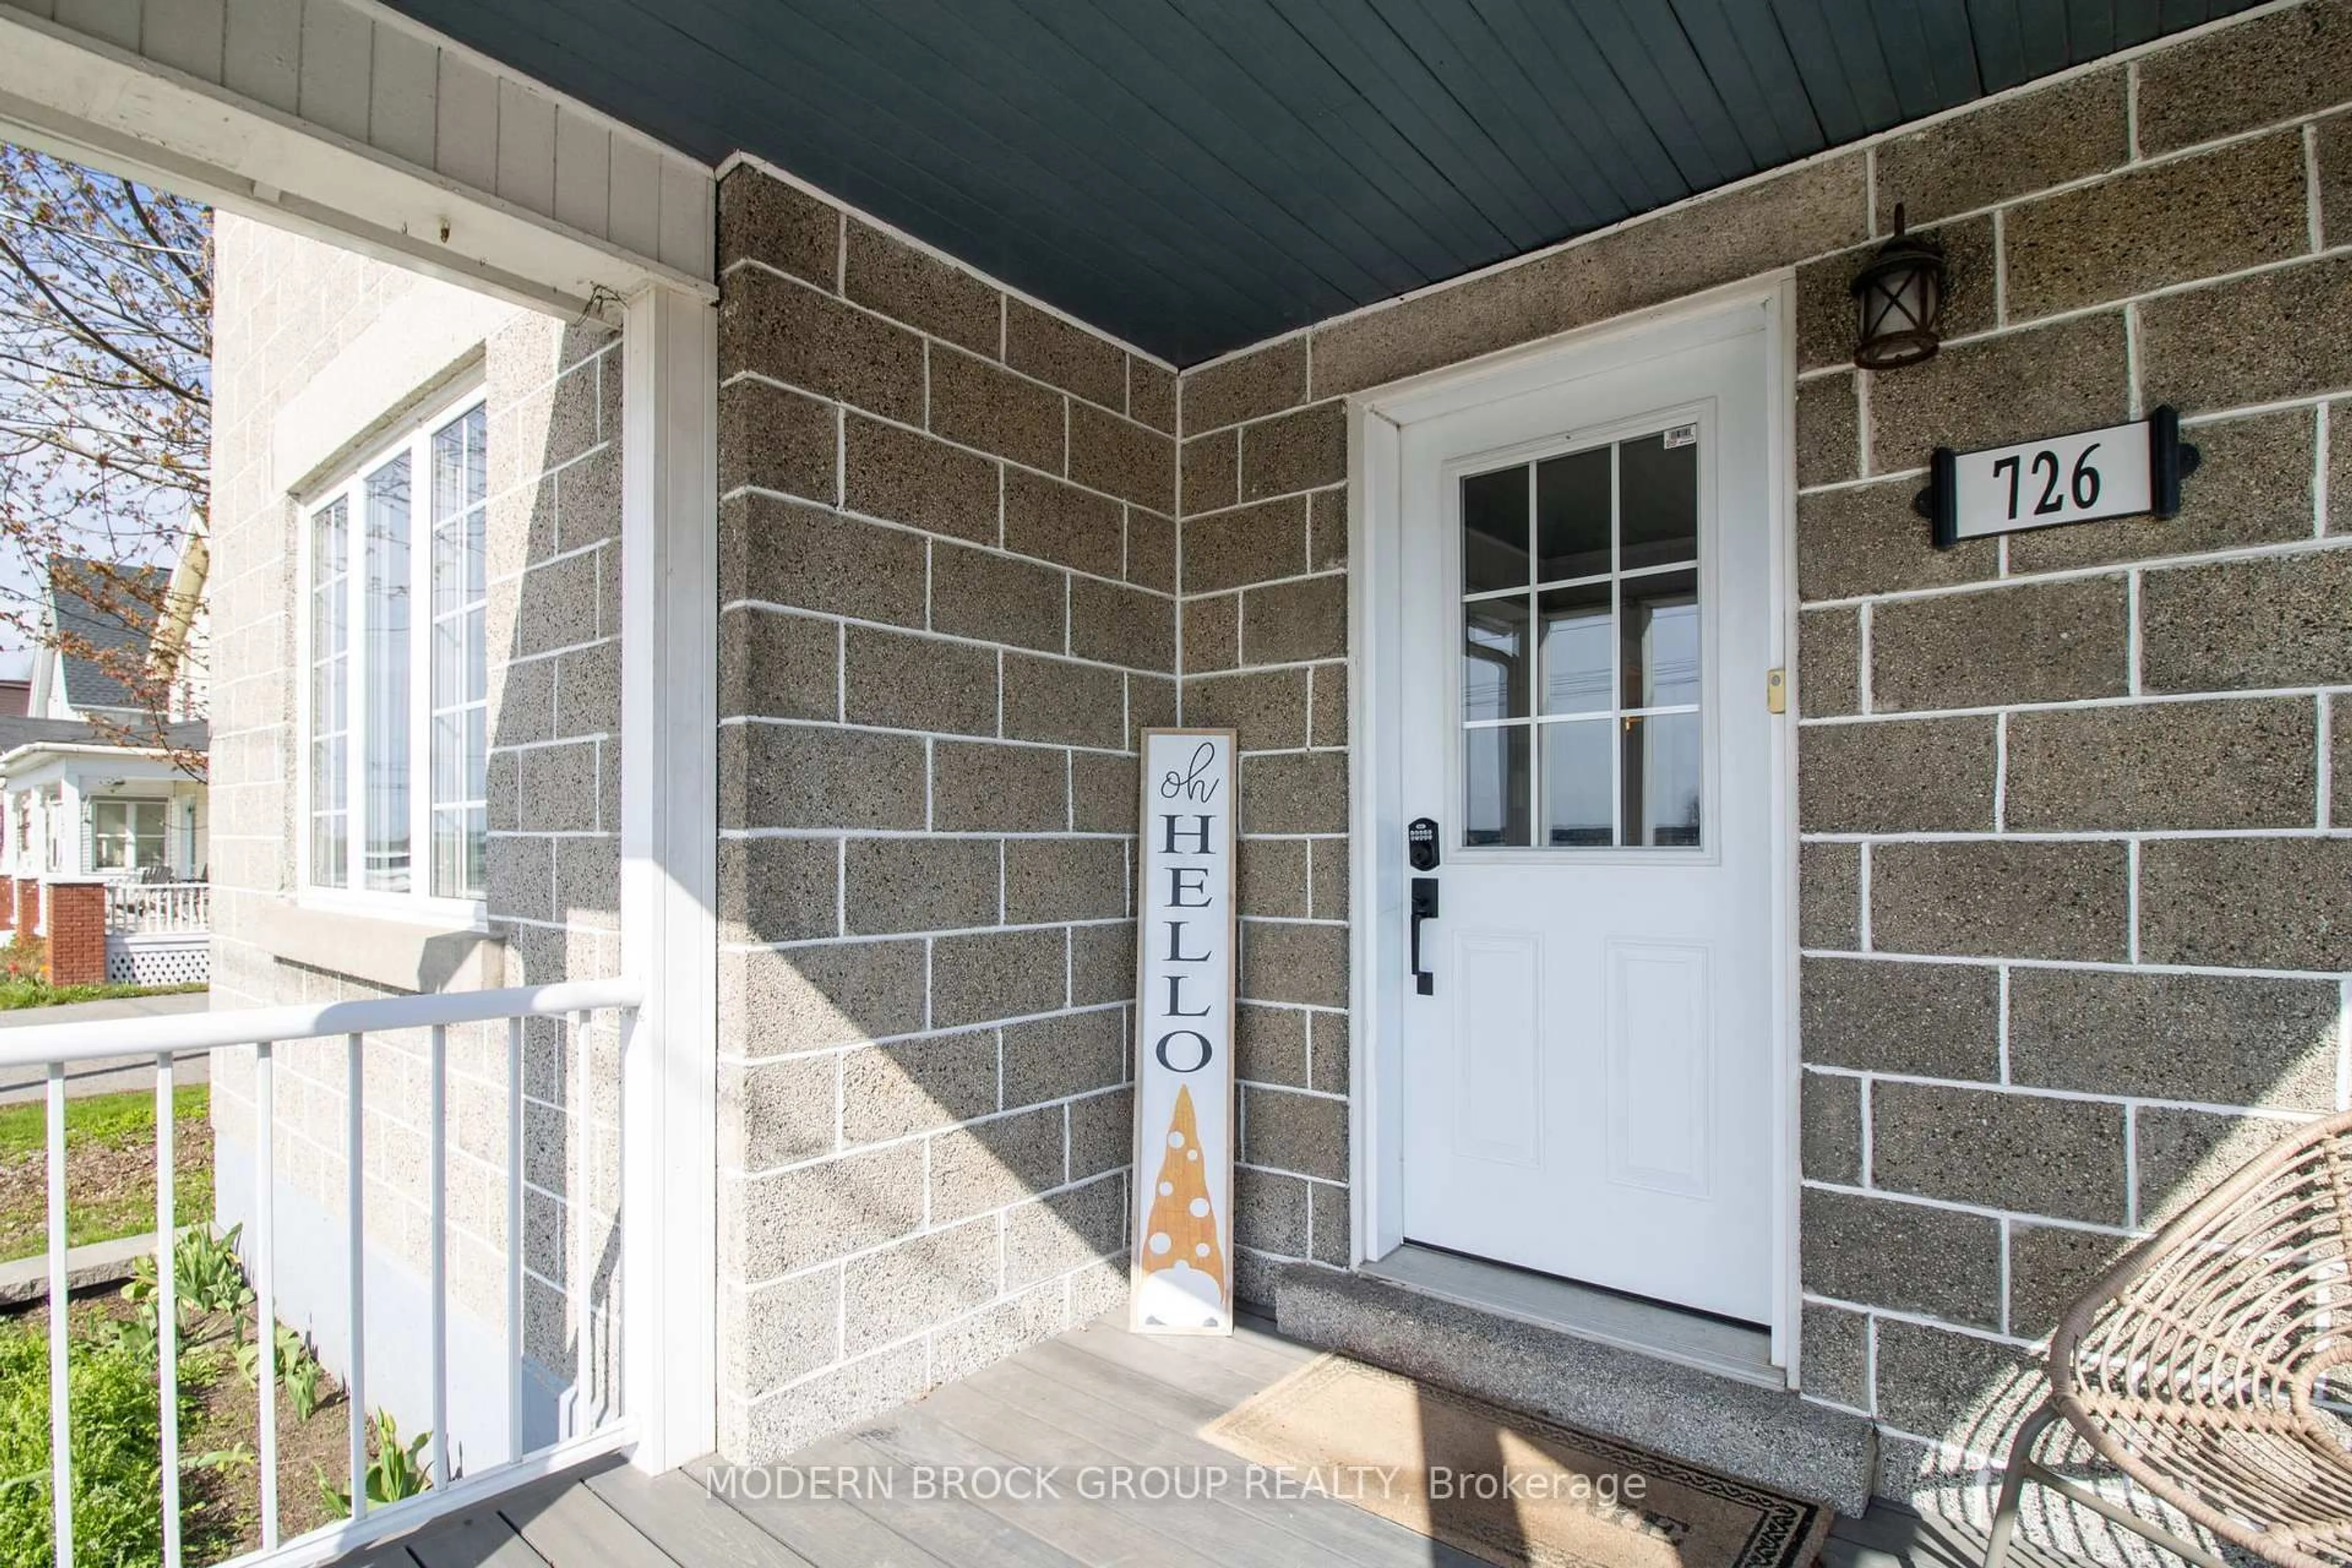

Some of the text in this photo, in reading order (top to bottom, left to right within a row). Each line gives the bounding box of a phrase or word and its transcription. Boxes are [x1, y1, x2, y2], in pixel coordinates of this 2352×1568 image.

[1992, 443, 2101, 520] 726
[1160, 742, 1219, 803] oh
[1156, 814, 1216, 1073] HELLO
